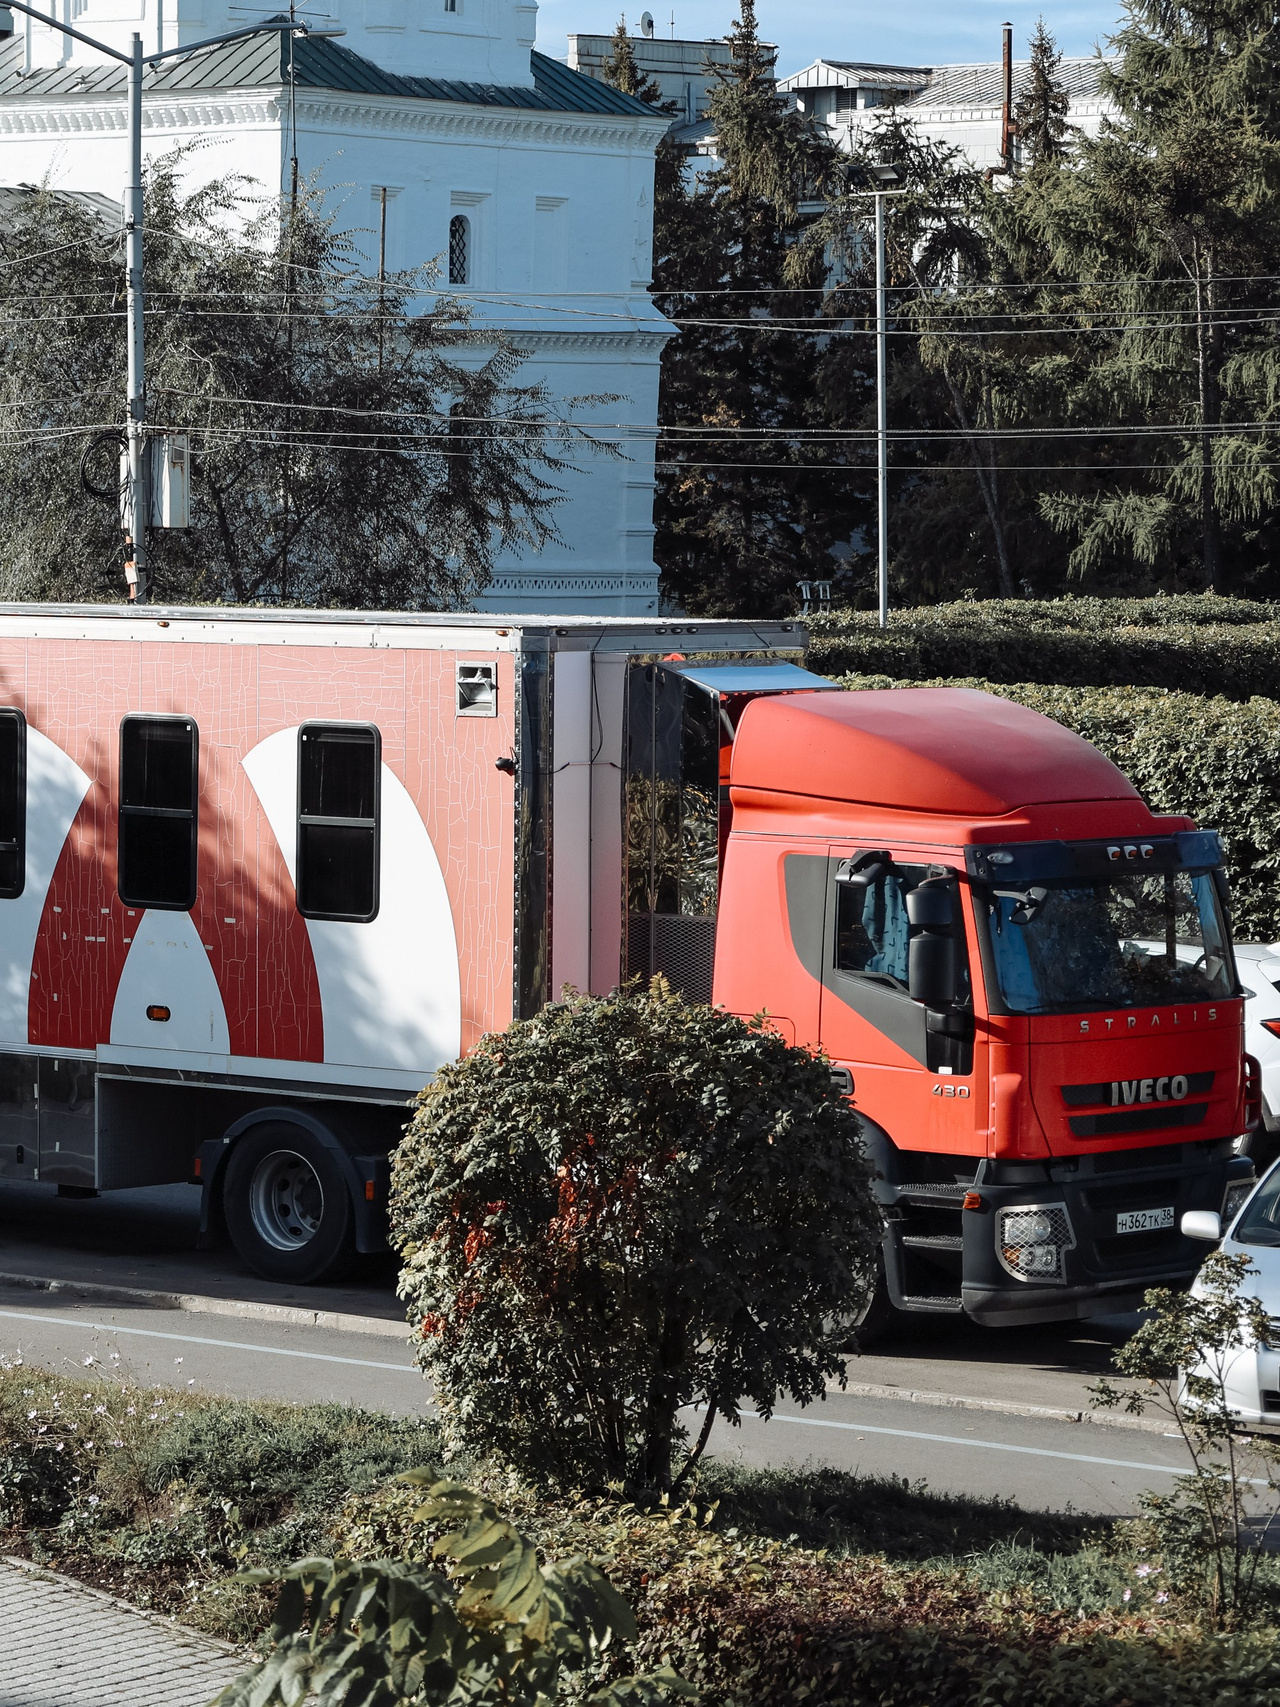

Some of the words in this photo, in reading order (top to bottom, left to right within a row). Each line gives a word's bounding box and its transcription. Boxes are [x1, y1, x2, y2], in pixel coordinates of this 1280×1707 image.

[1079, 1008, 1217, 1033] STRALIS
[932, 1083, 970, 1099] 430
[1111, 1075, 1188, 1107] IVECO
